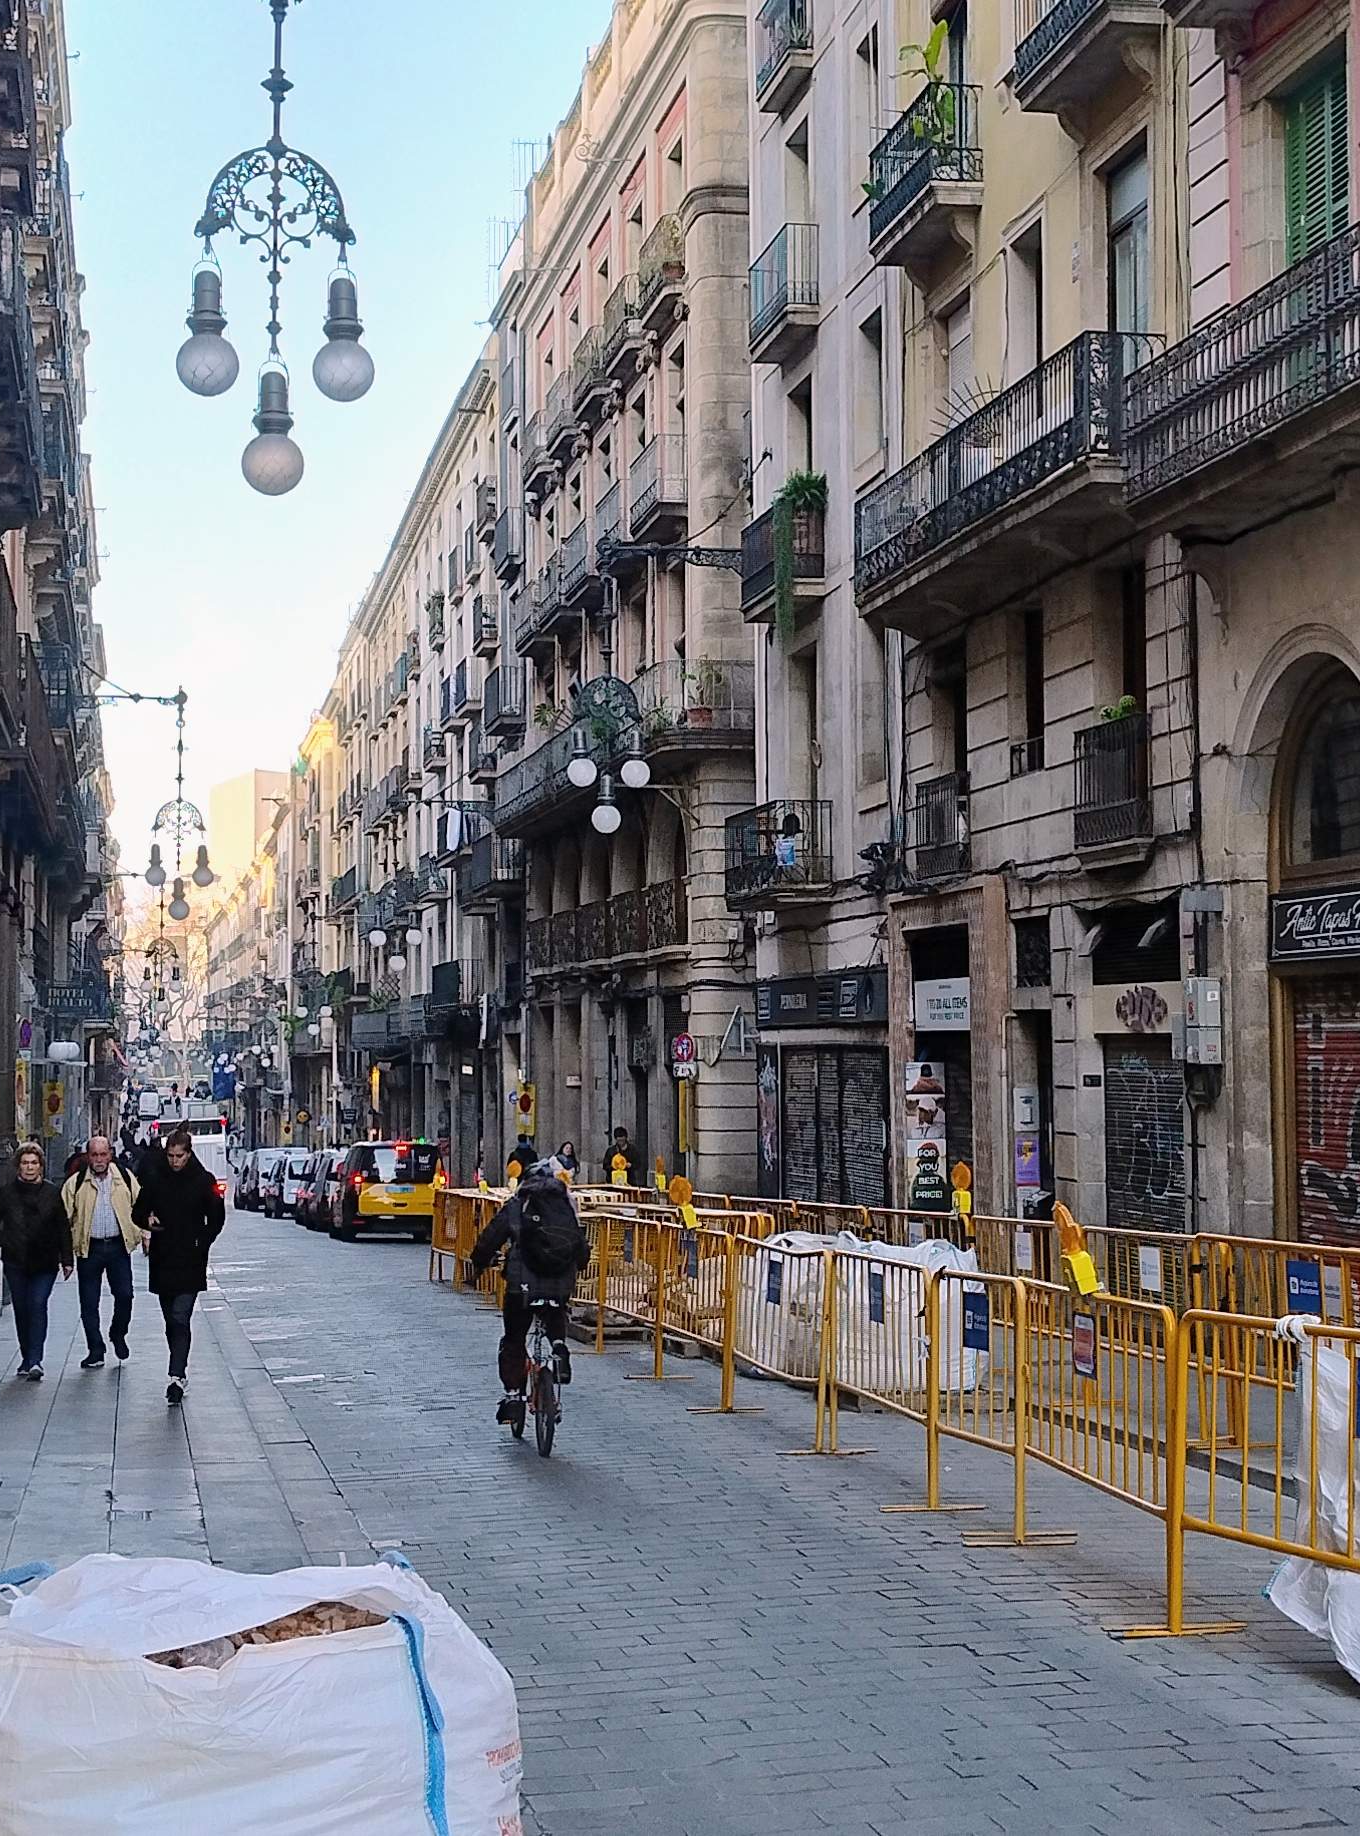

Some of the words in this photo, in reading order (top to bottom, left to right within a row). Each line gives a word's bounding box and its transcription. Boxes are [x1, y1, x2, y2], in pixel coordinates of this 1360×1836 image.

[1280, 904, 1317, 939] Antic
[1317, 899, 1353, 941] Tapas
[48, 987, 85, 998] HOTEL
[918, 1149, 937, 1157] FOR
[919, 1162, 938, 1171] YOU
[918, 1176, 939, 1185] BEST
